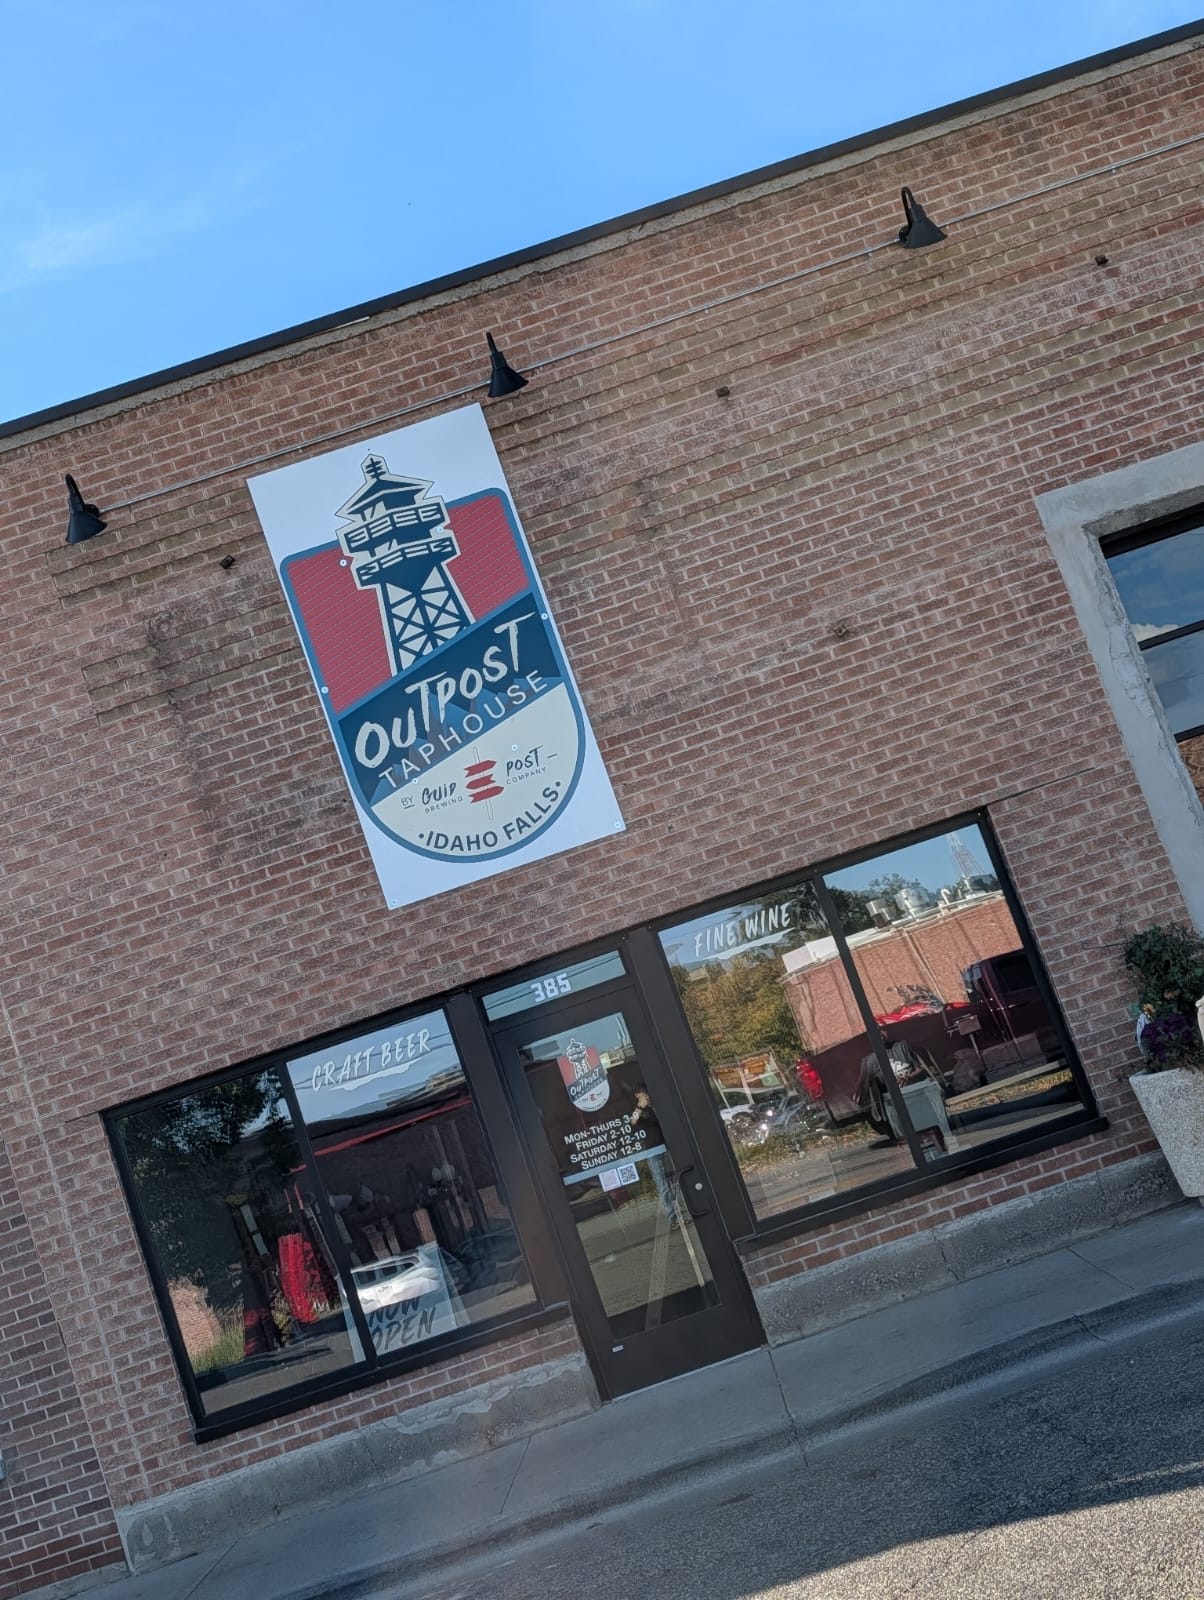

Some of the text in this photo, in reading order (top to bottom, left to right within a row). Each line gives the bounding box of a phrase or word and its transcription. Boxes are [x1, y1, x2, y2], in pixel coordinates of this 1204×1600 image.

[355, 611, 536, 768] OUTPOST
[378, 669, 548, 788] TAPHOUSE
[400, 795, 414, 807] BY
[506, 745, 543, 776] POST
[424, 766, 546, 814] BREWING COMPANY
[425, 786, 559, 851] IDAHO FALLS
[694, 898, 798, 957] FINE WINE
[530, 973, 572, 1002] 385
[312, 1028, 431, 1092] CRAFT BEER
[570, 1068, 600, 1096] OUTPOST
[564, 1111, 640, 1145] MON-THURS 3-9
[570, 1129, 647, 1163] SATURDAY 12-10
[575, 1125, 632, 1151] FRIDAY 2-10
[581, 1142, 642, 1170] SUNDAY 12-8
[371, 1305, 437, 1350] OPEN
